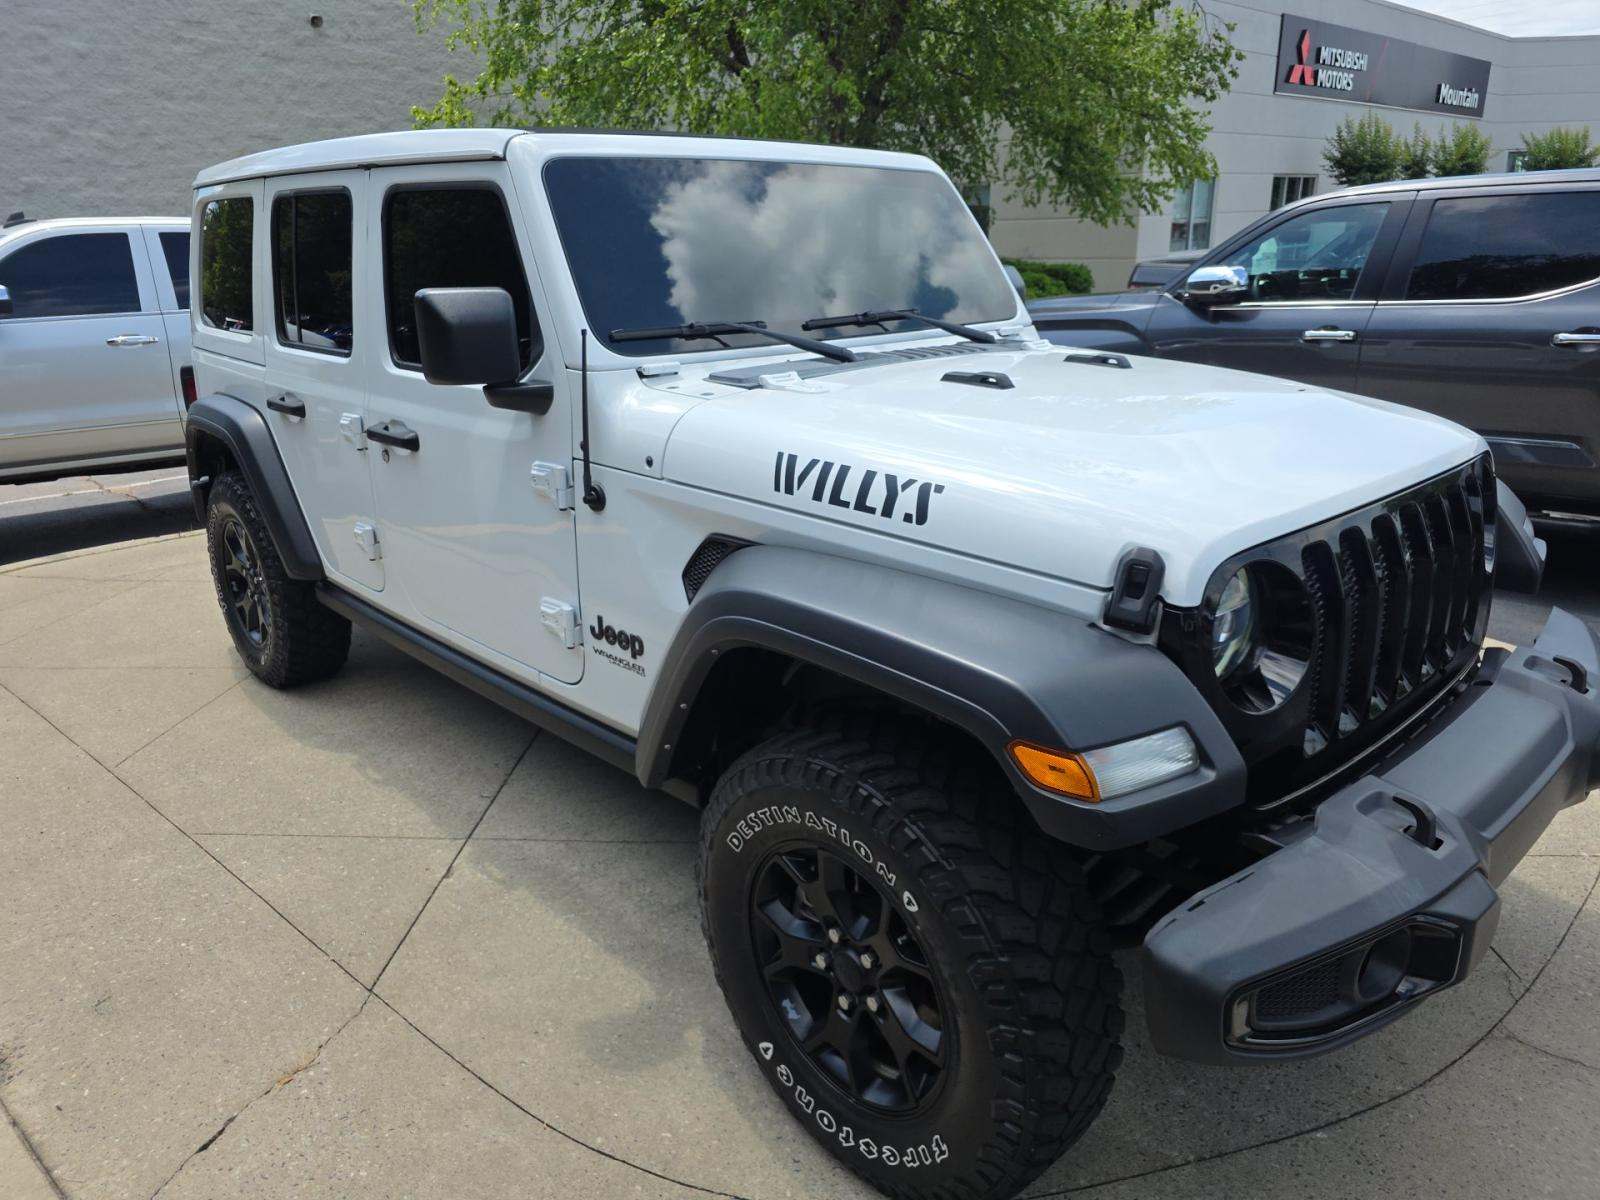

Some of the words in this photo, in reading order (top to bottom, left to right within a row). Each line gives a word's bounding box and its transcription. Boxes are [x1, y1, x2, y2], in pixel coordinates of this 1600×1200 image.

[1319, 46, 1368, 71] MITSUBISHI
[1317, 69, 1354, 91] MOTORS
[1438, 83, 1479, 109] Mountain
[774, 451, 945, 526] WILLYS
[590, 614, 645, 660] Jeep
[726, 805, 896, 887] DESTINATION
